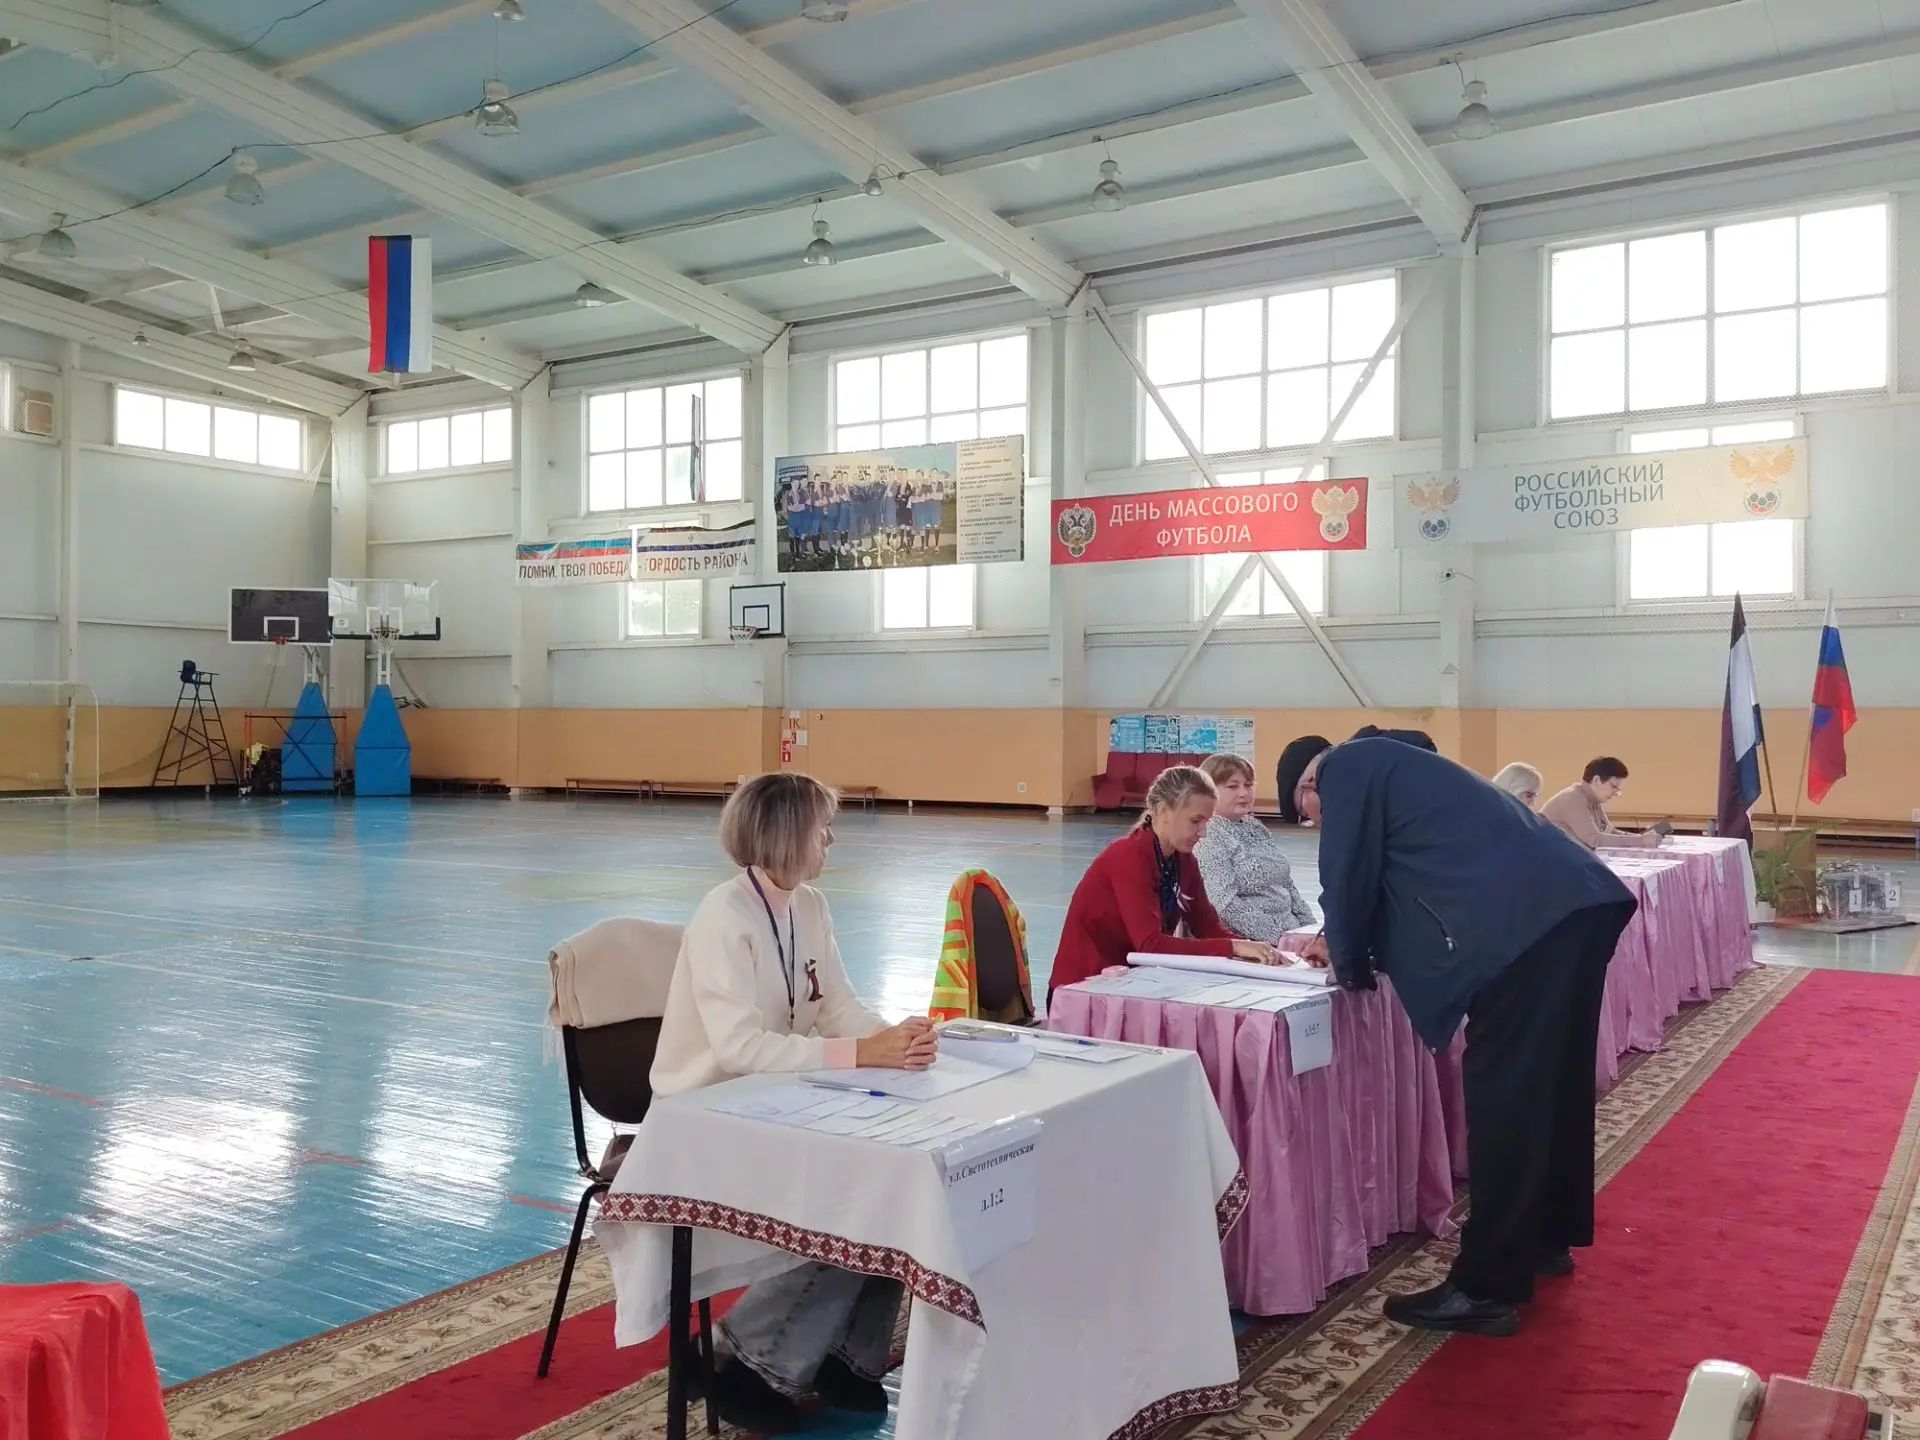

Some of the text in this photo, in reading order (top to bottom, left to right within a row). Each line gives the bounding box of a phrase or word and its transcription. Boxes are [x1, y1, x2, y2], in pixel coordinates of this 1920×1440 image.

[1514, 459, 1664, 493] РОССИЙСКИЙ
[1513, 483, 1665, 512] ФУТБОЛЬНЫЙ
[1109, 491, 1299, 527] ДЕНЬ МАССОВОГО
[1553, 508, 1619, 529] СОЮЗ
[1156, 523, 1253, 548] ФУТБОЛА
[560, 562, 586, 577] ТВОЯ
[703, 551, 749, 570] РАЙОНА
[1853, 893, 1859, 906] 1
[1888, 889, 1897, 902] 2
